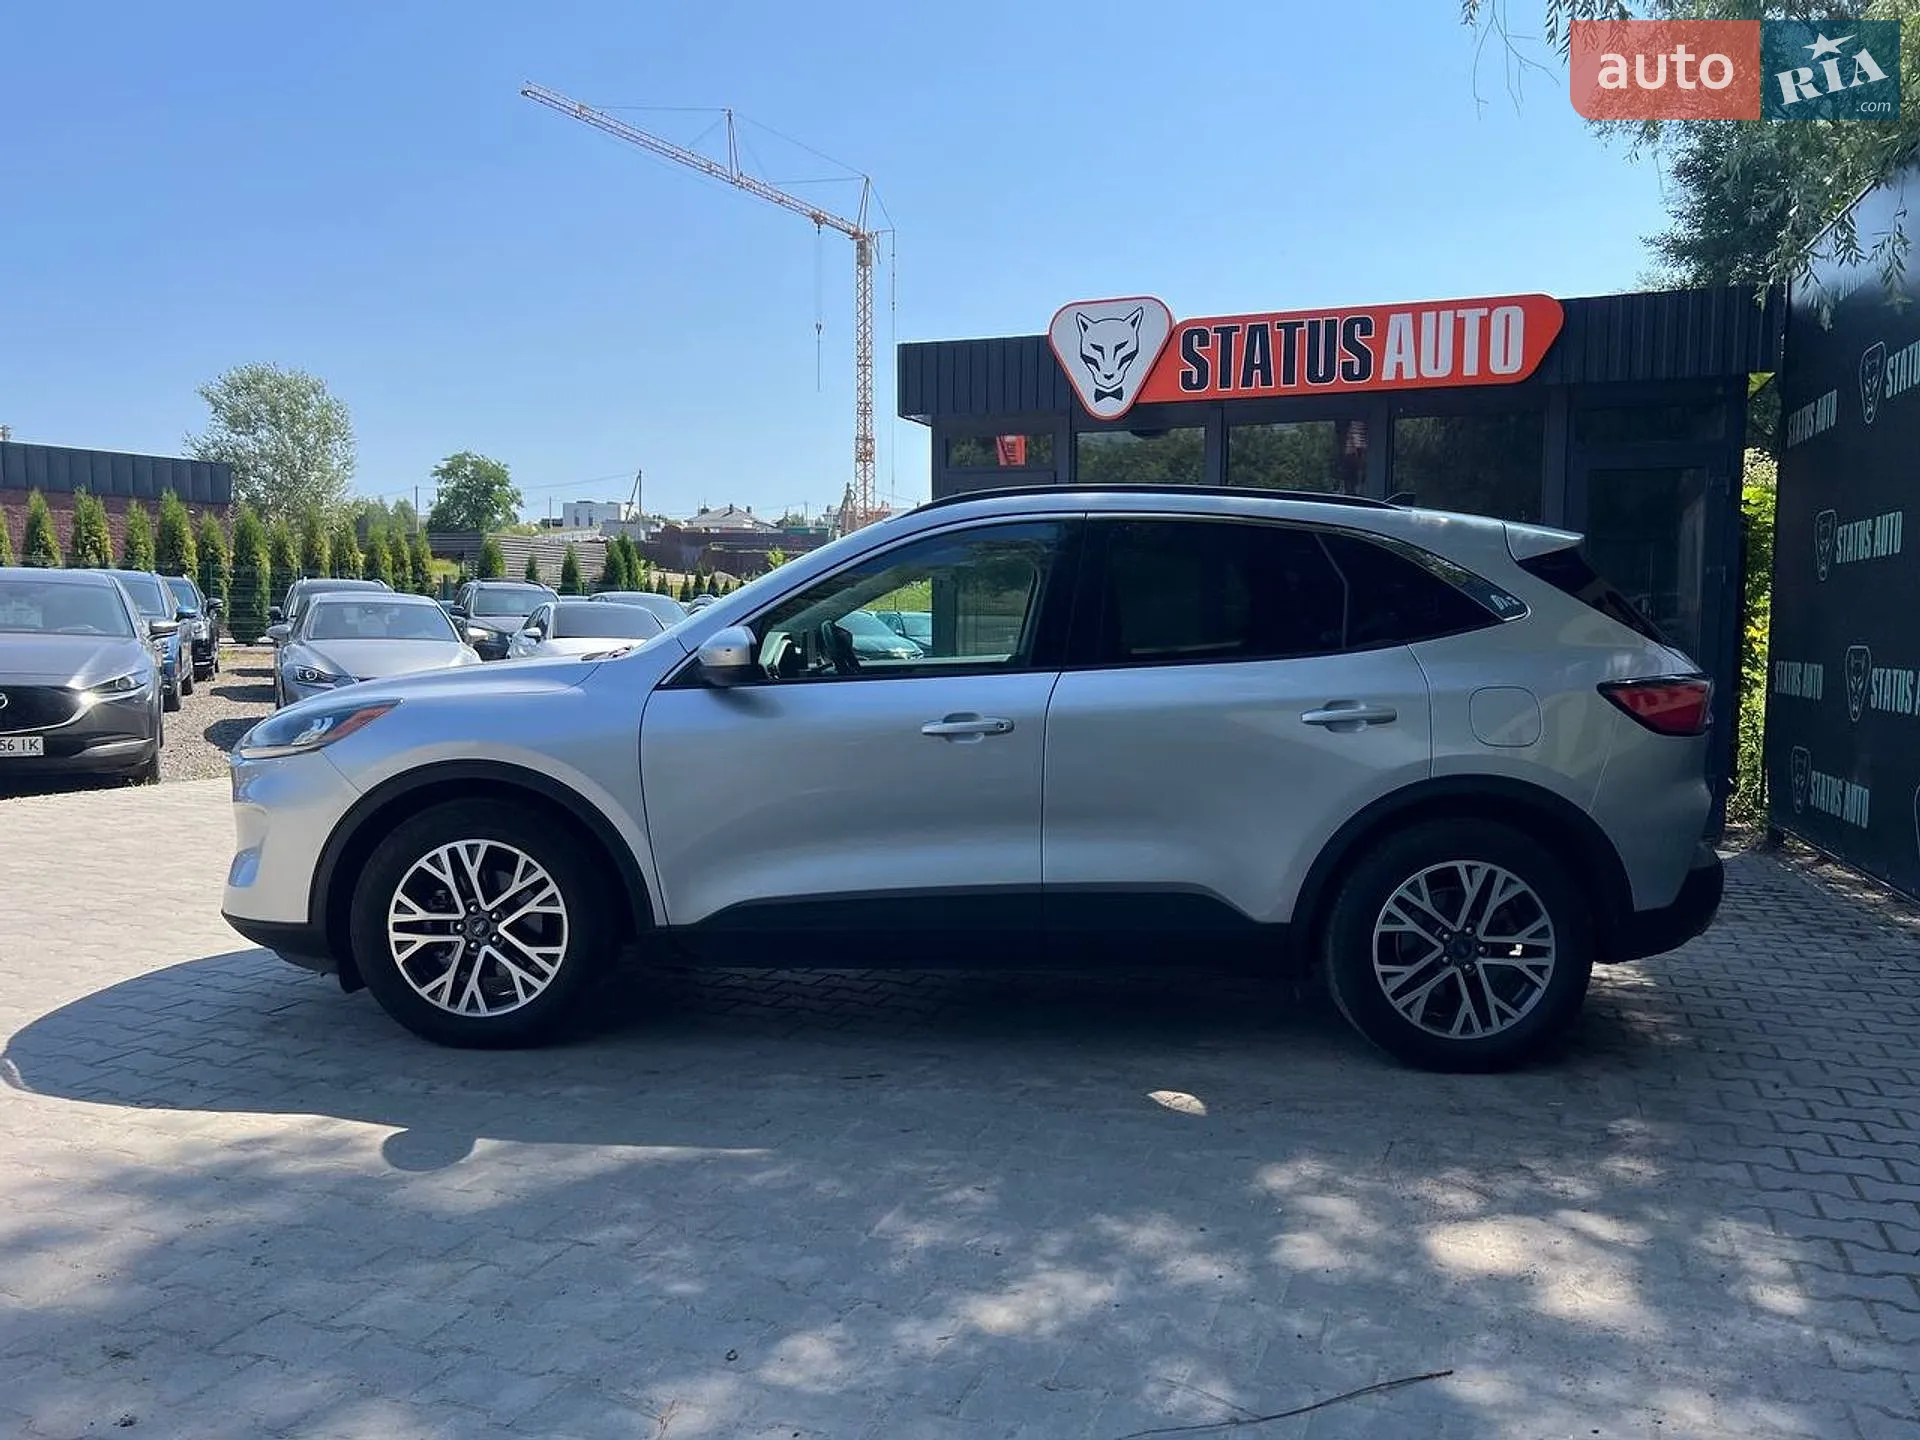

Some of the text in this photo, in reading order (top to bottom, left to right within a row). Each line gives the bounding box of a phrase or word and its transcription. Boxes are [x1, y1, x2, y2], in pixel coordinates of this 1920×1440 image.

[1178, 306, 1525, 392] STATUS AUTO
[1787, 389, 1837, 448] STATUS AUTO
[1836, 511, 1902, 563] STATUS AUTO
[1774, 660, 1823, 700] STATUS AUTO
[1869, 667, 1914, 714] STATUS
[1810, 770, 1870, 829] STATUS AUTO
